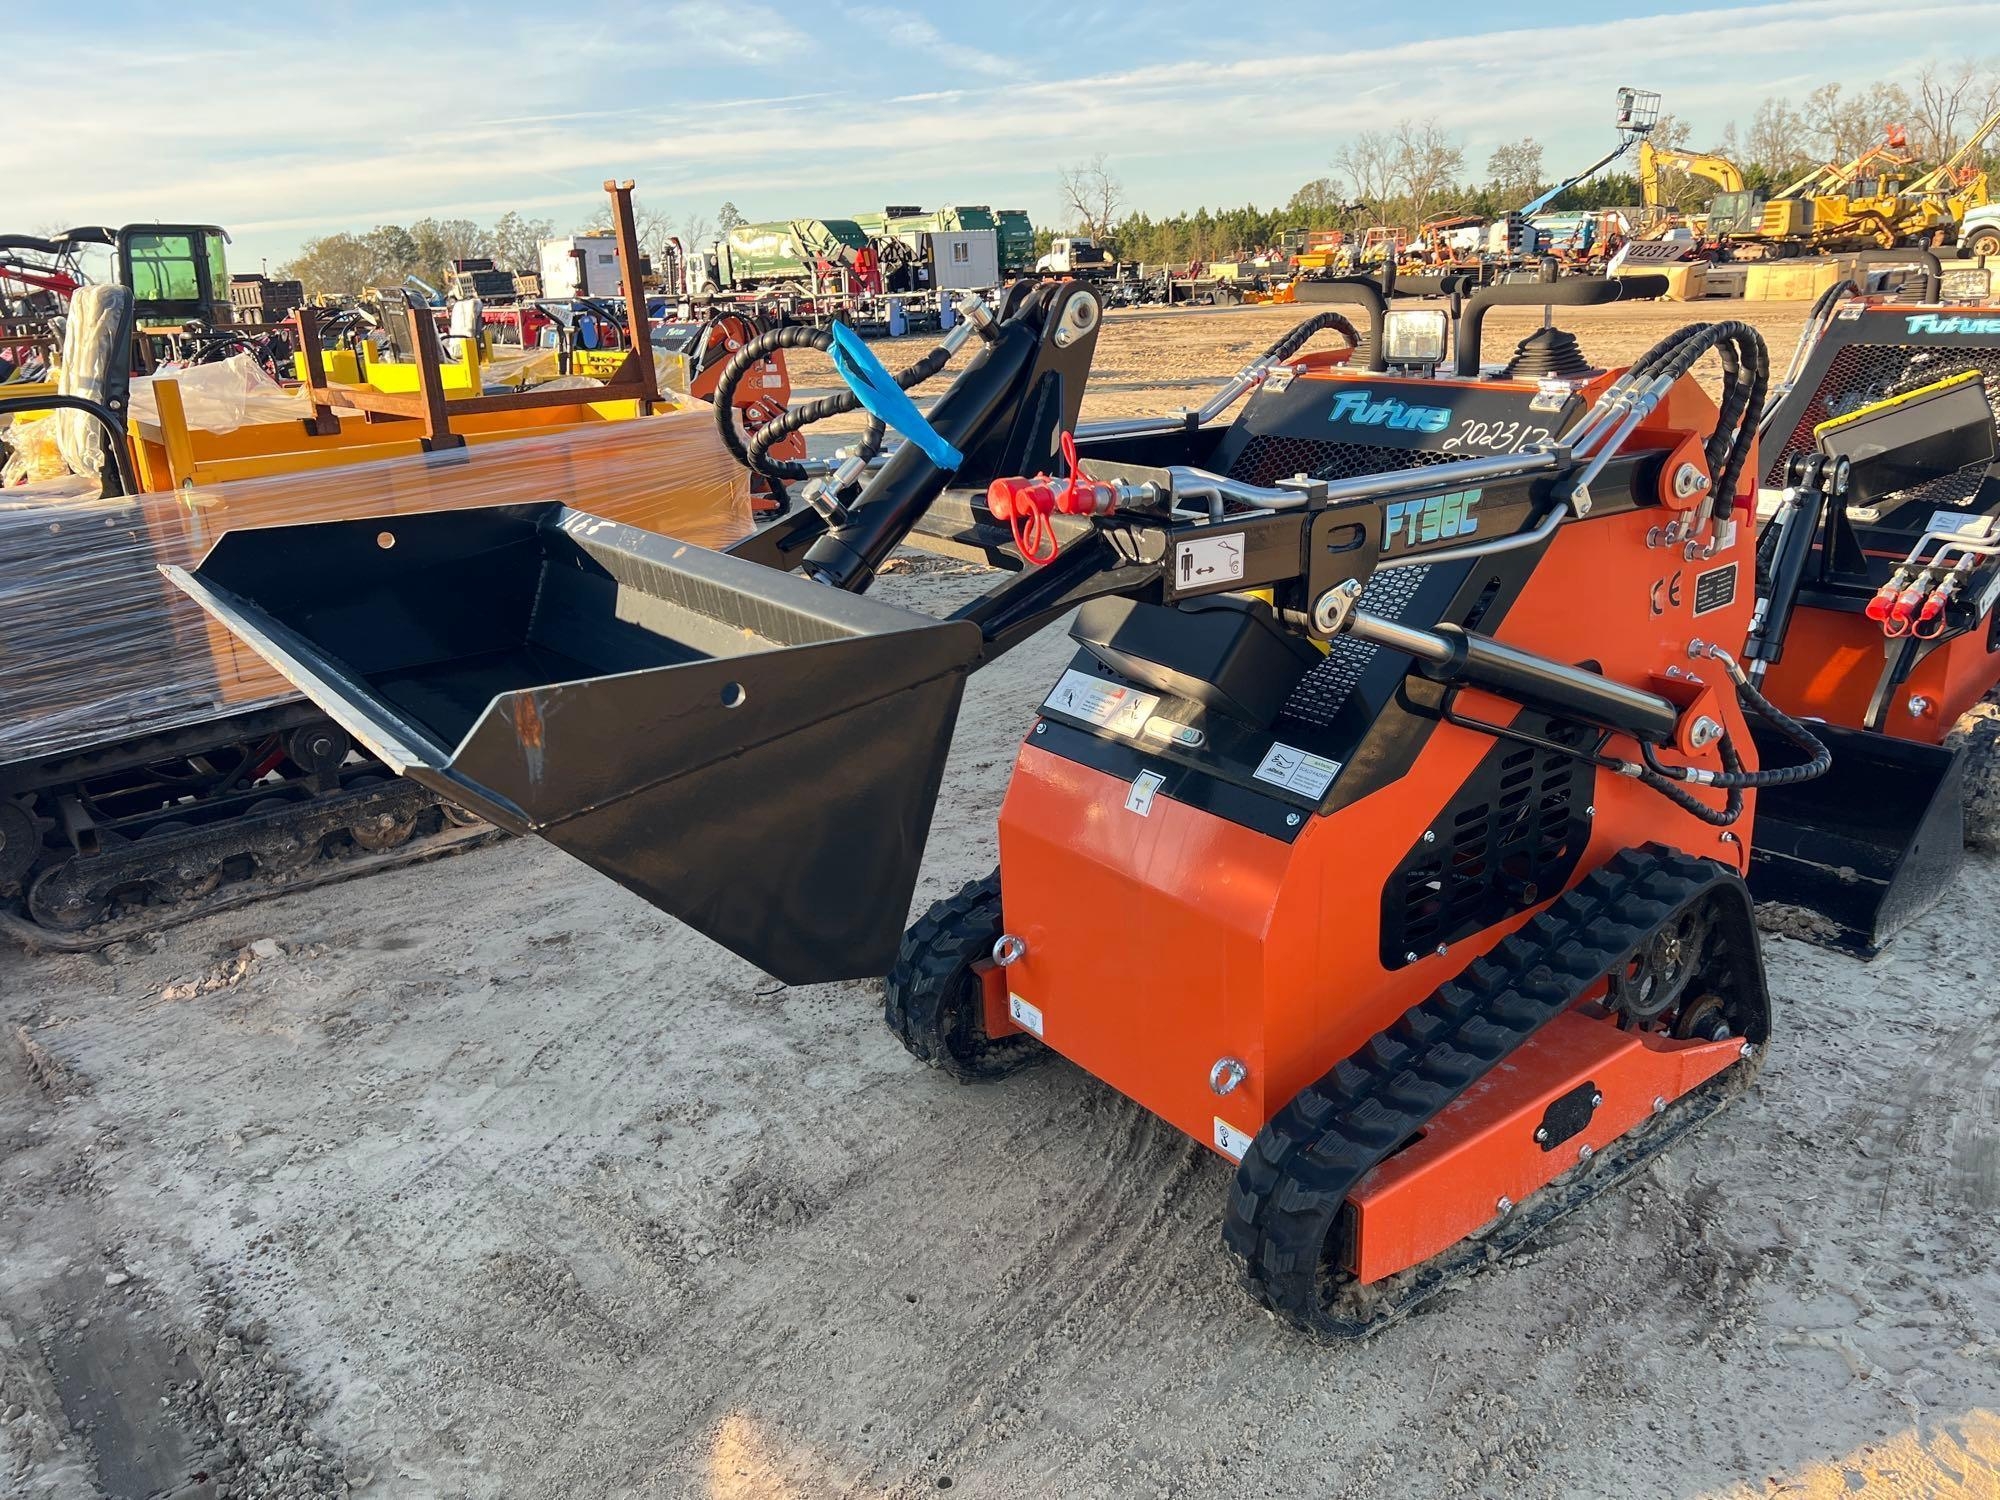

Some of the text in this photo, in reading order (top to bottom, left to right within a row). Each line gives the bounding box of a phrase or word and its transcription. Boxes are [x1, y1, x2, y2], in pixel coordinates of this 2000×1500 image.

[1630, 245, 1679, 258] 02312
[1328, 391, 1452, 433] Future
[1382, 488, 1483, 551] FT36C
